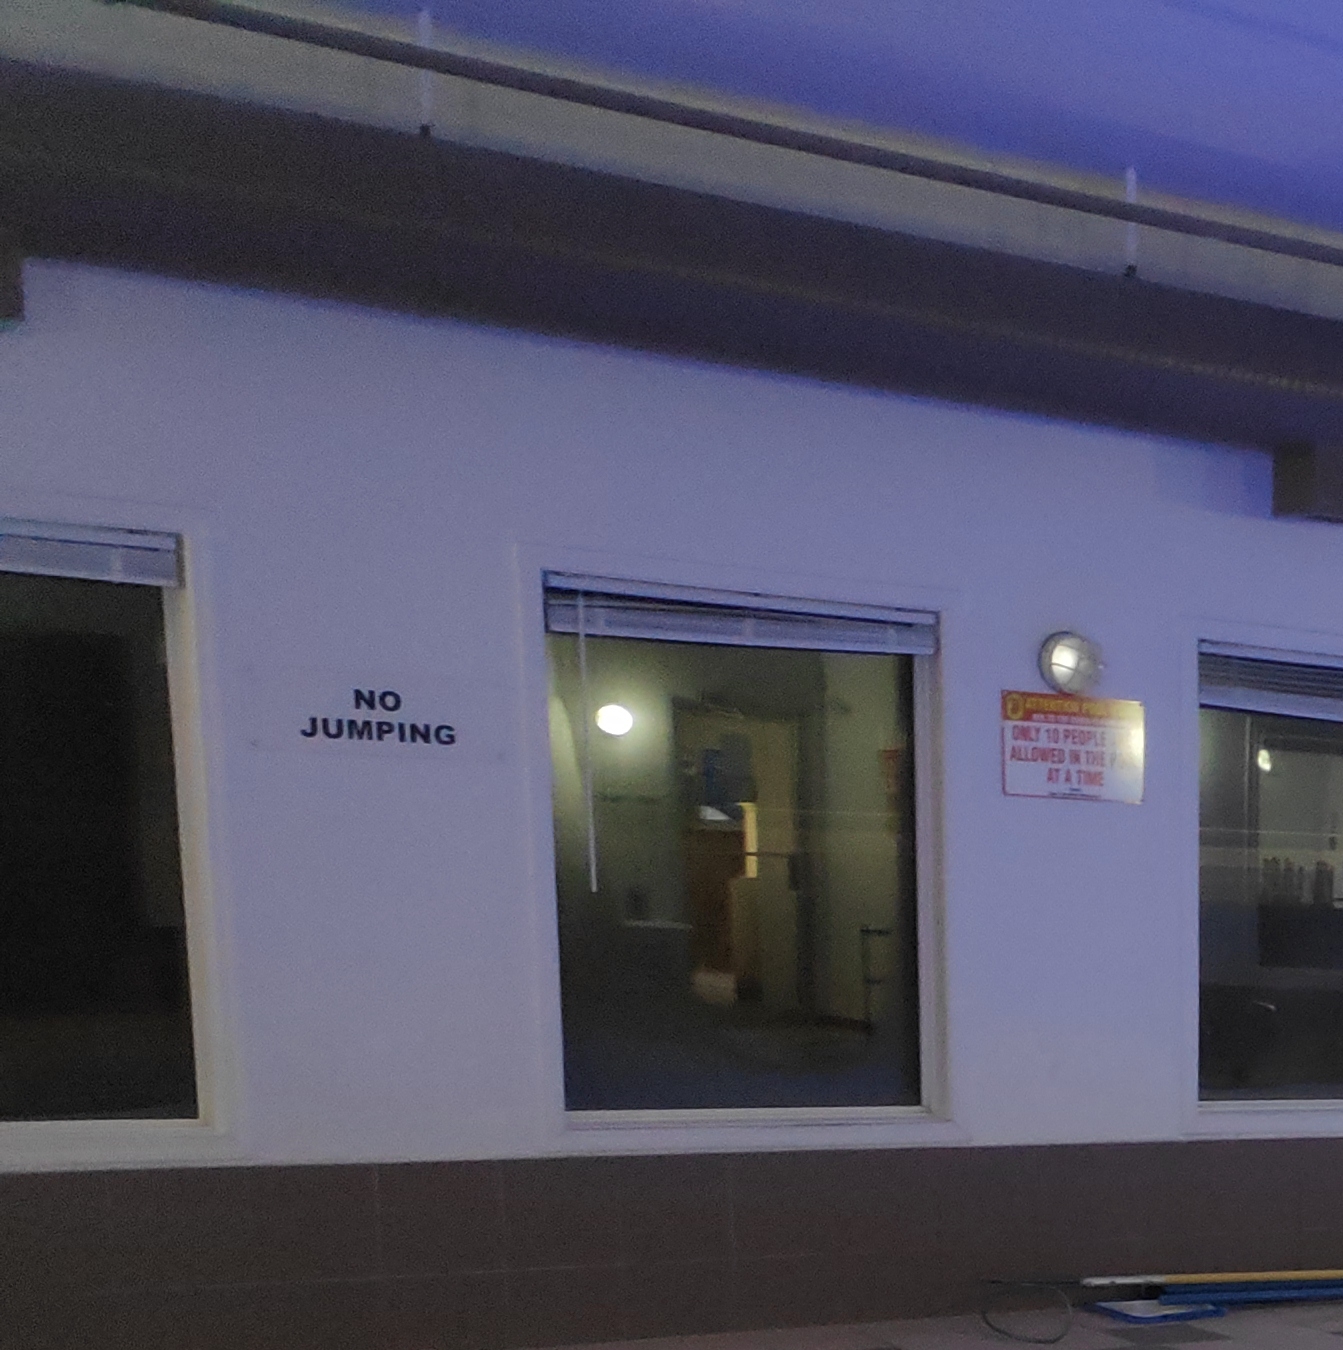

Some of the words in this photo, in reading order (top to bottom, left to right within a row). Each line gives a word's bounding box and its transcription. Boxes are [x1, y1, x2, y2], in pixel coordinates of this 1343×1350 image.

[354, 689, 402, 712] NO
[301, 717, 456, 745] JUMPING
[1012, 725, 1041, 742] ONLY
[1063, 729, 1106, 747] PEOPLE
[1010, 746, 1065, 764] ALLOWED
[1085, 750, 1105, 767] THE
[1047, 768, 1060, 783] AT
[1065, 769, 1072, 783] A
[1076, 770, 1104, 786] TIME
